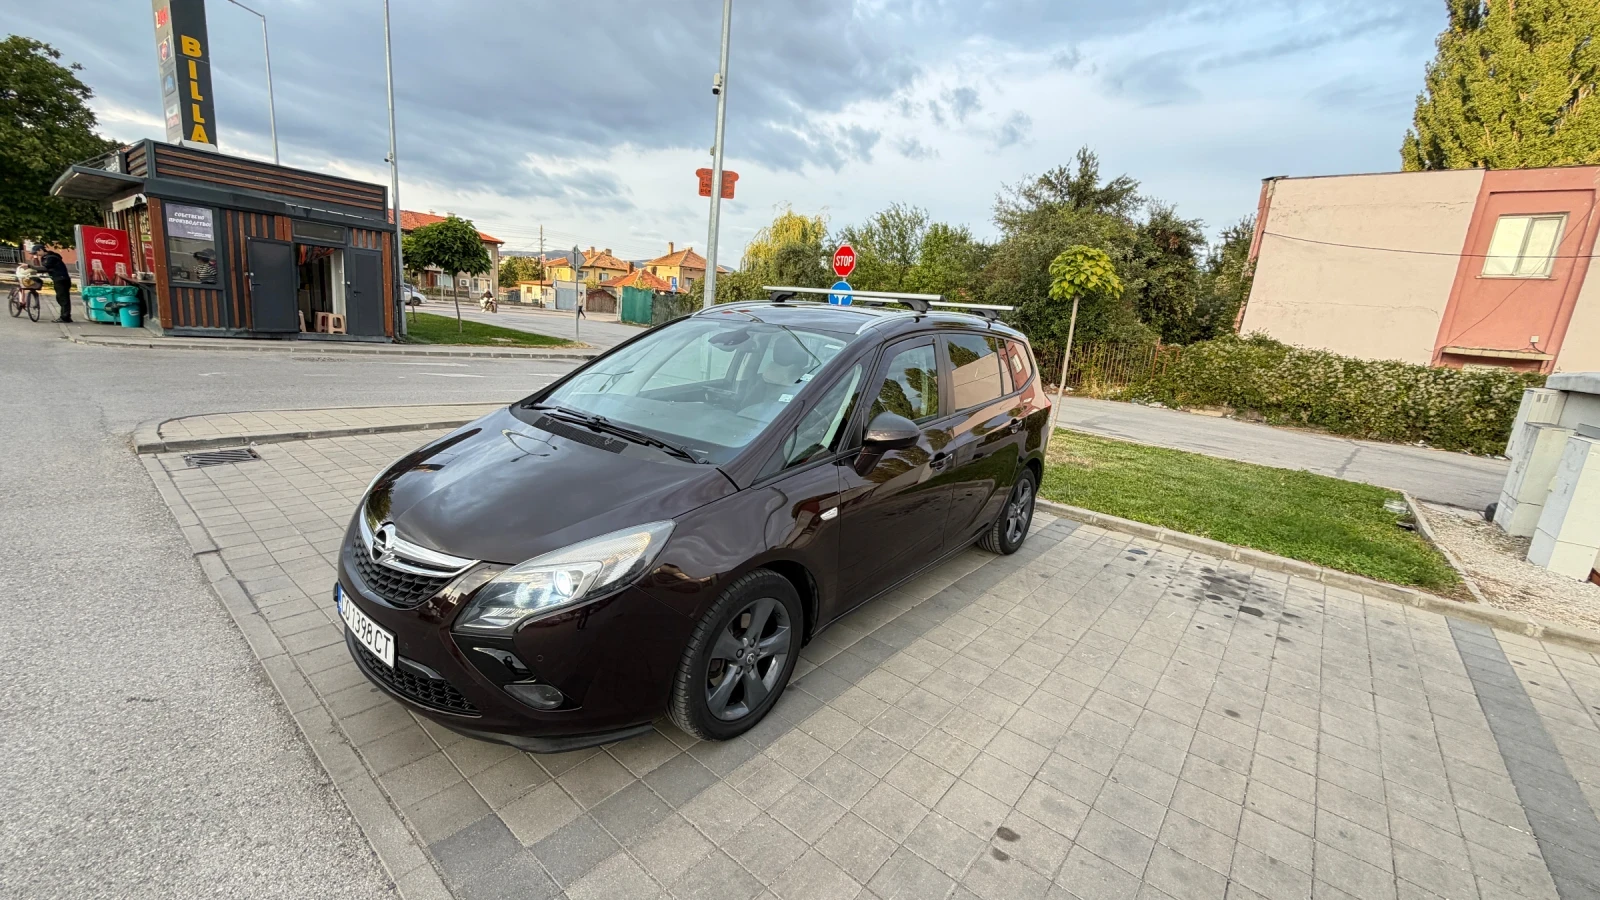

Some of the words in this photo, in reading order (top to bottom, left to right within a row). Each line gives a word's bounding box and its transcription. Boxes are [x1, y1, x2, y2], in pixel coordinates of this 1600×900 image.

[181, 35, 209, 143] BILLA
[174, 212, 205, 220] СОБСТВЕНО
[835, 255, 854, 267] STOP
